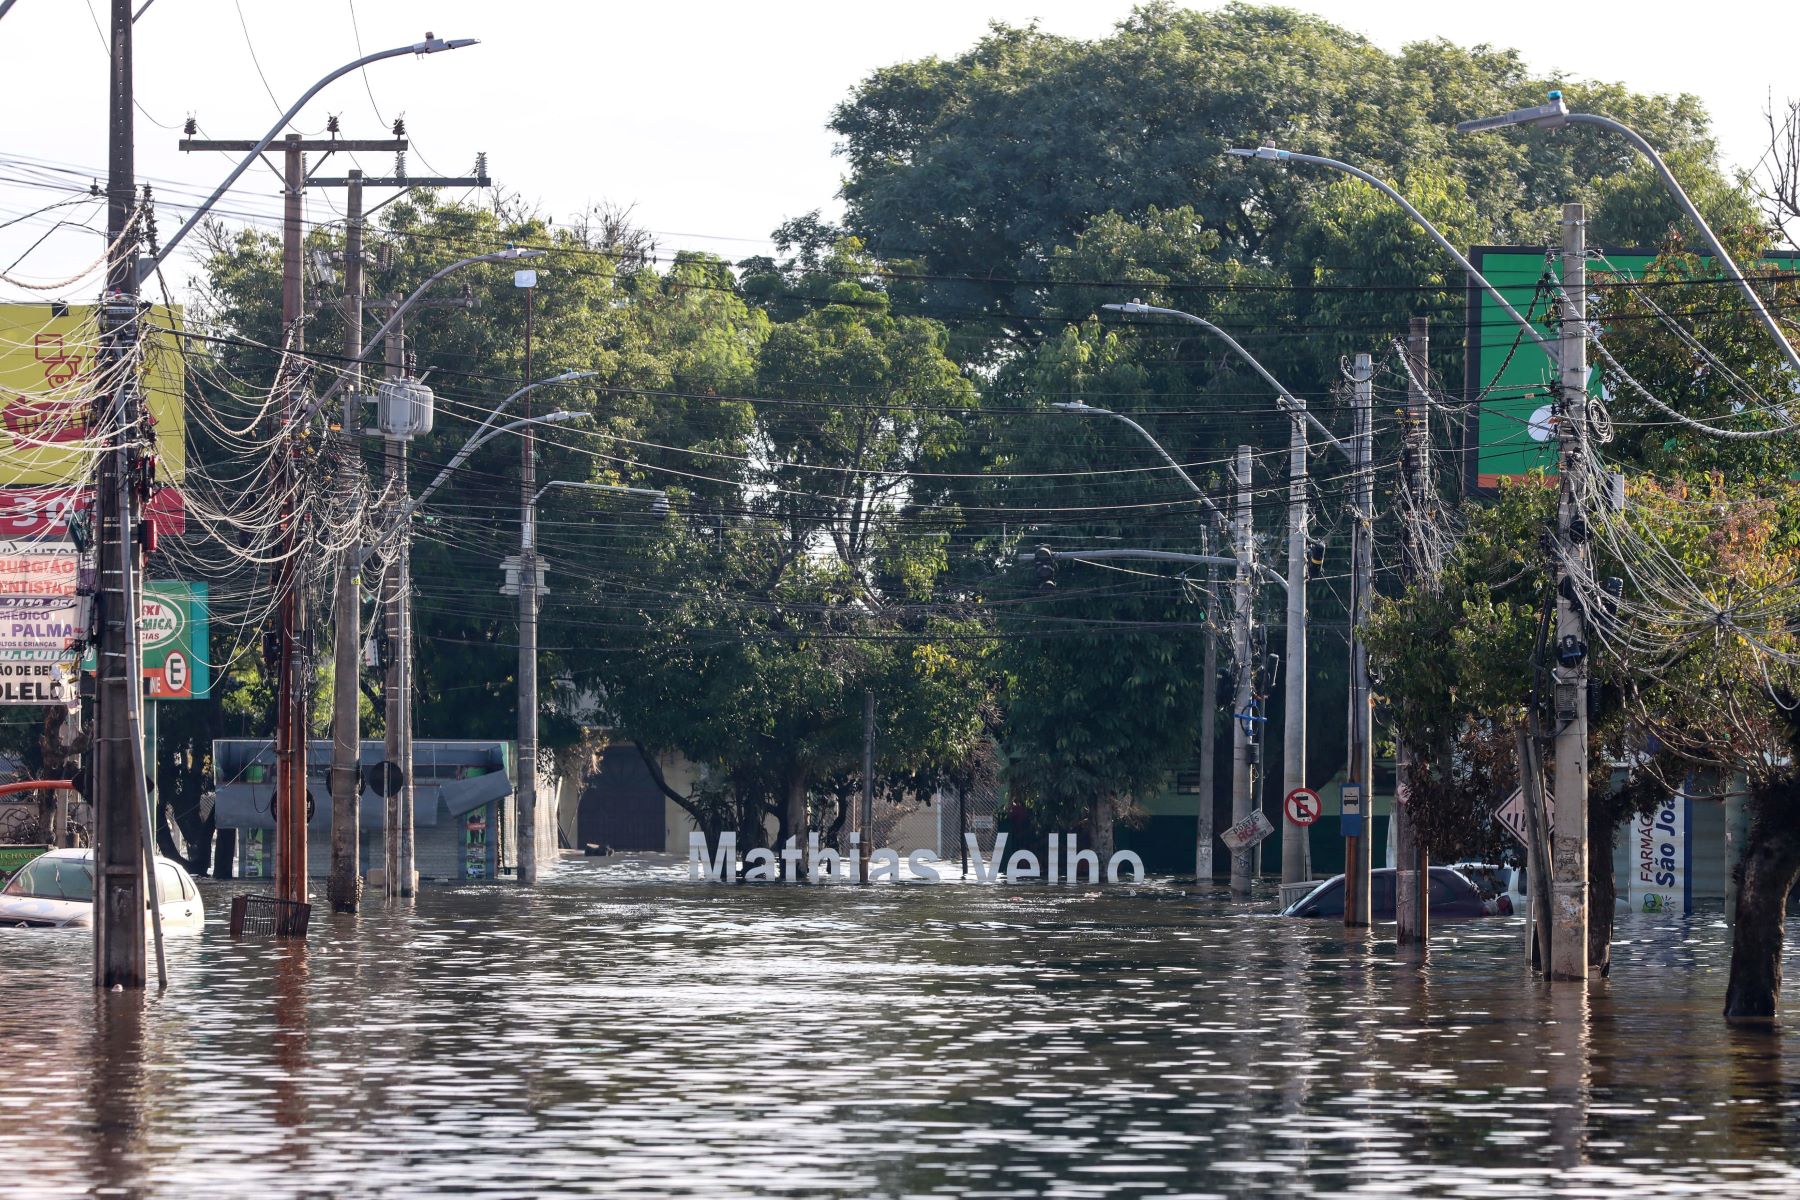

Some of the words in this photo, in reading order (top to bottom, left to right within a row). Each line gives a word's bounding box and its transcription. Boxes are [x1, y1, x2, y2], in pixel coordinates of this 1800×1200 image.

[12, 623, 72, 637] PALMA
[24, 641, 57, 649] CRIANÇAS
[16, 665, 32, 676] DE
[170, 658, 182, 685] E
[689, 831, 941, 884] Mathias
[964, 832, 1145, 885] Velho
[1655, 843, 1675, 888] São
